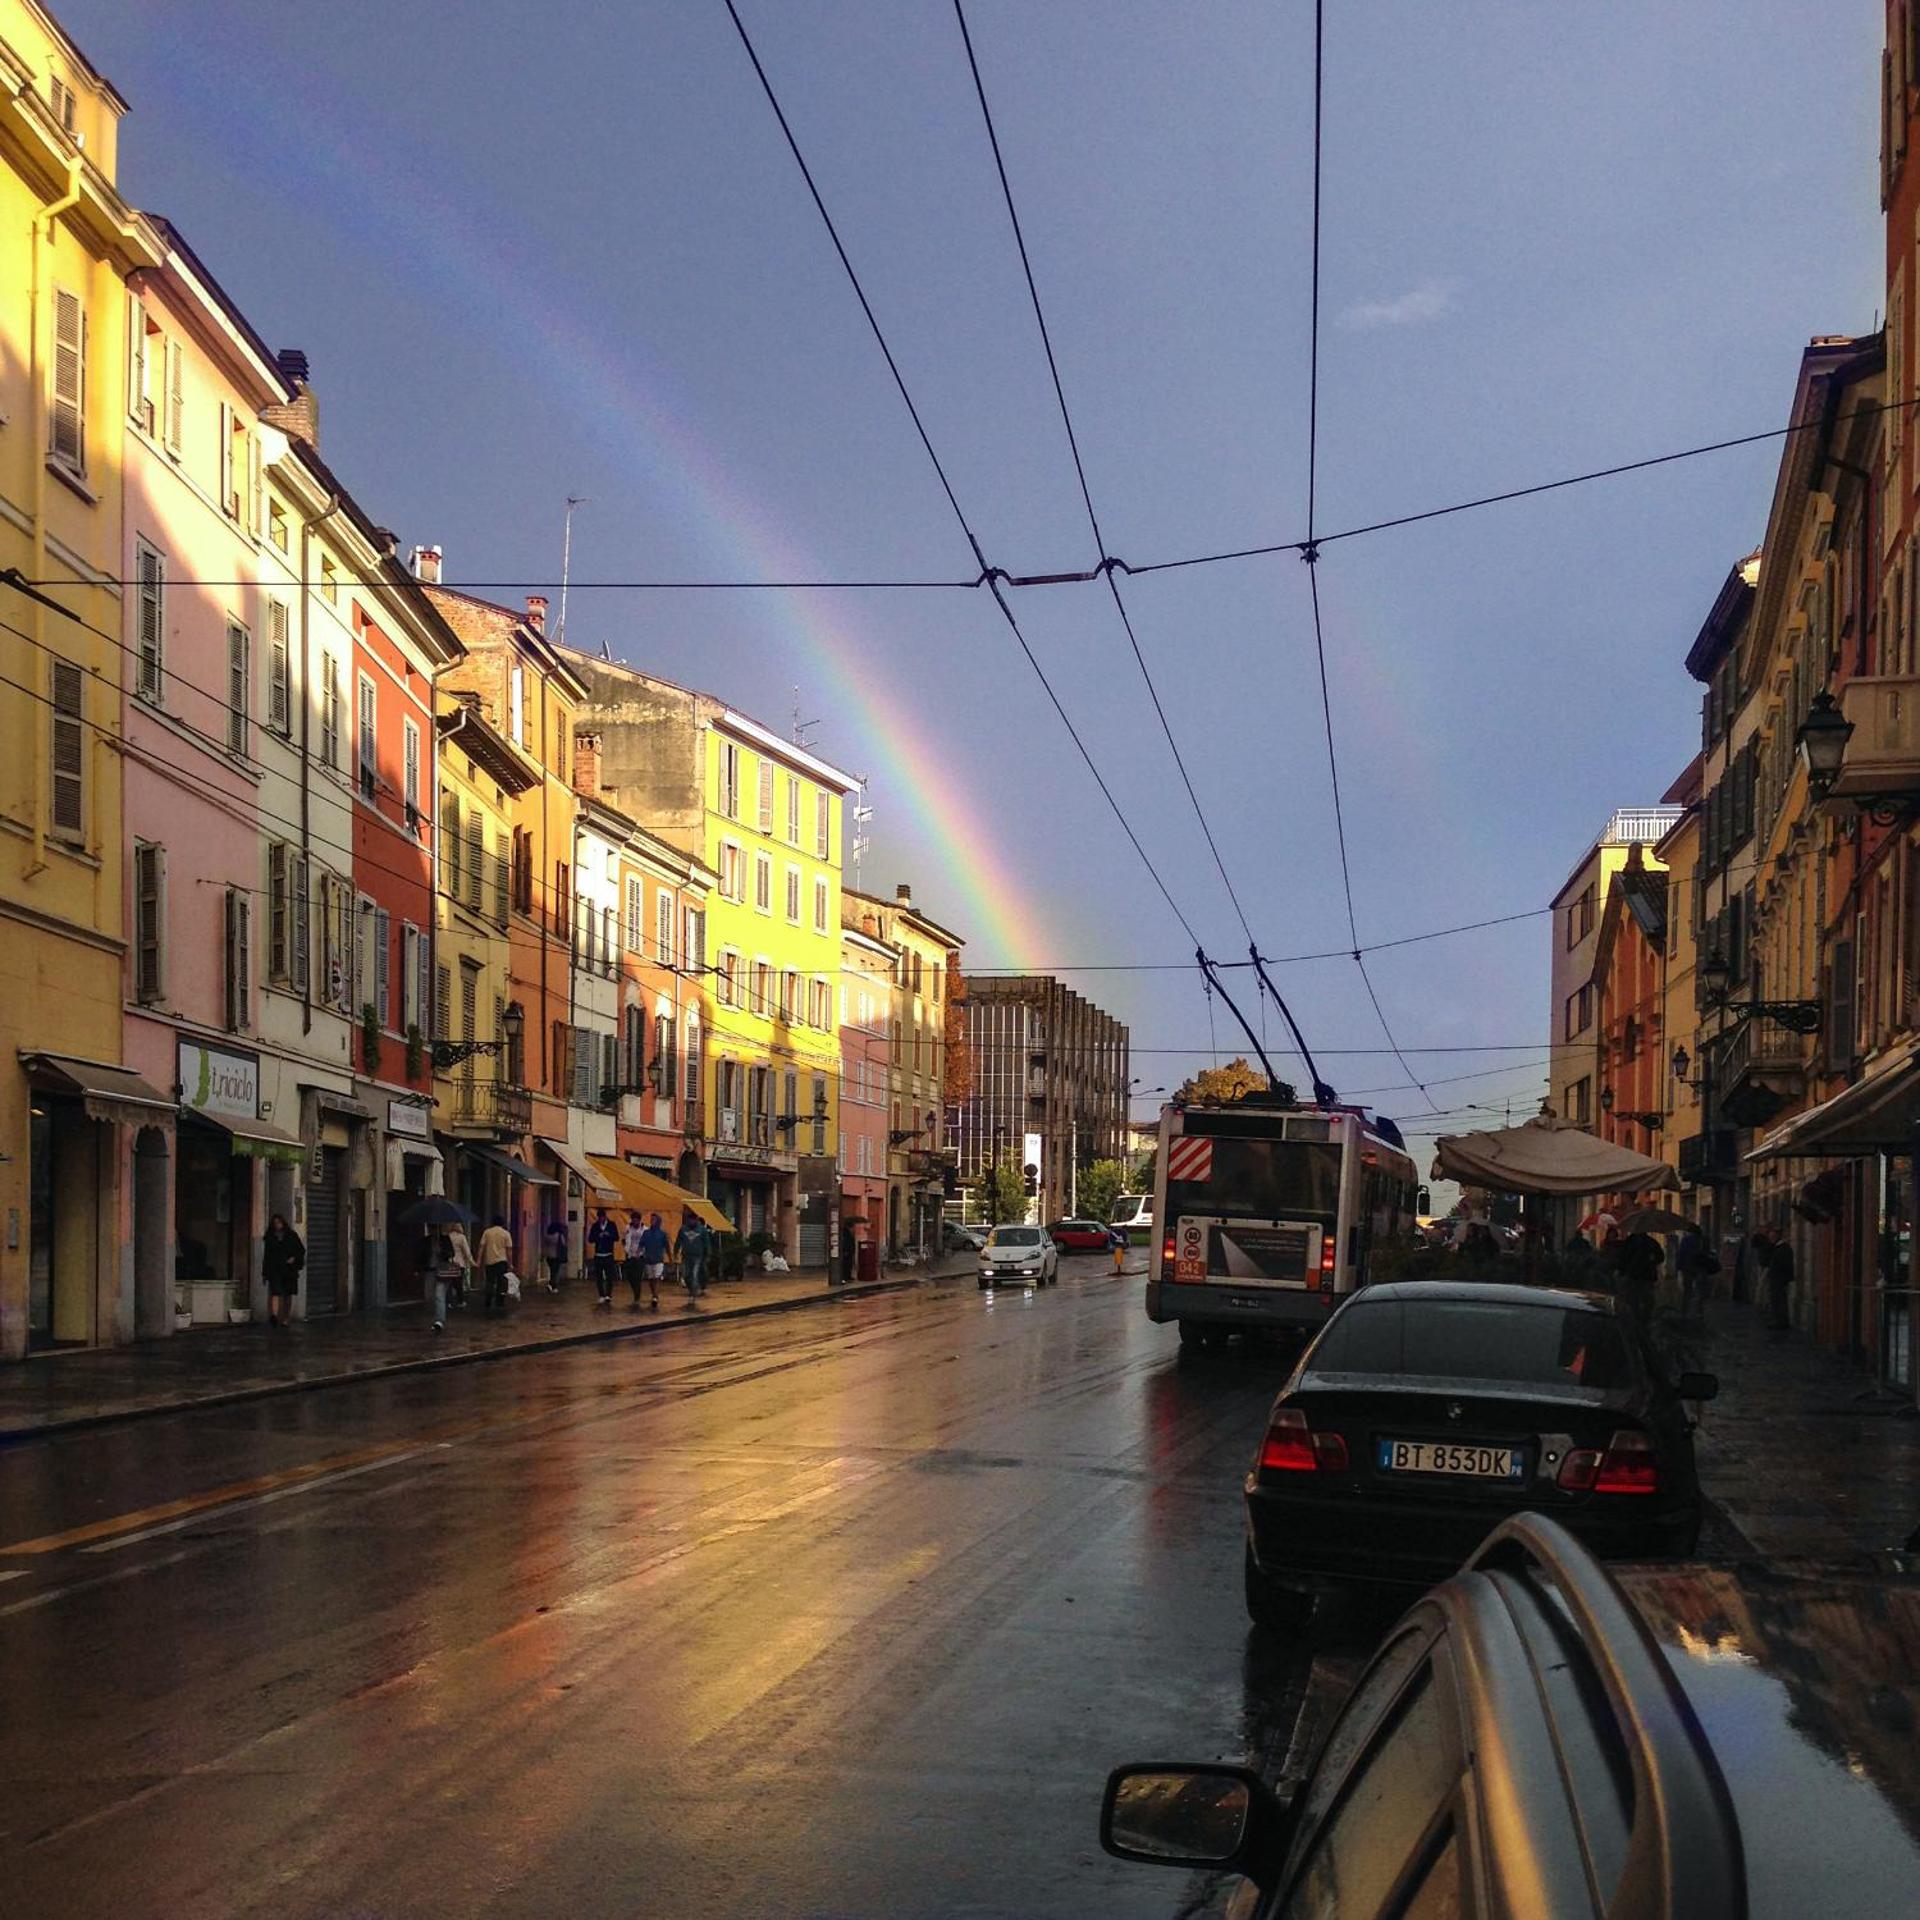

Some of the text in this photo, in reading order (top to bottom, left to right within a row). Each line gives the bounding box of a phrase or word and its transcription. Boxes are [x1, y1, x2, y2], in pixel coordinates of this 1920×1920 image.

[312, 1145, 323, 1177] PASTA
[1180, 1263, 1200, 1275] 042
[1396, 1444, 1506, 1474] BT 853DK
